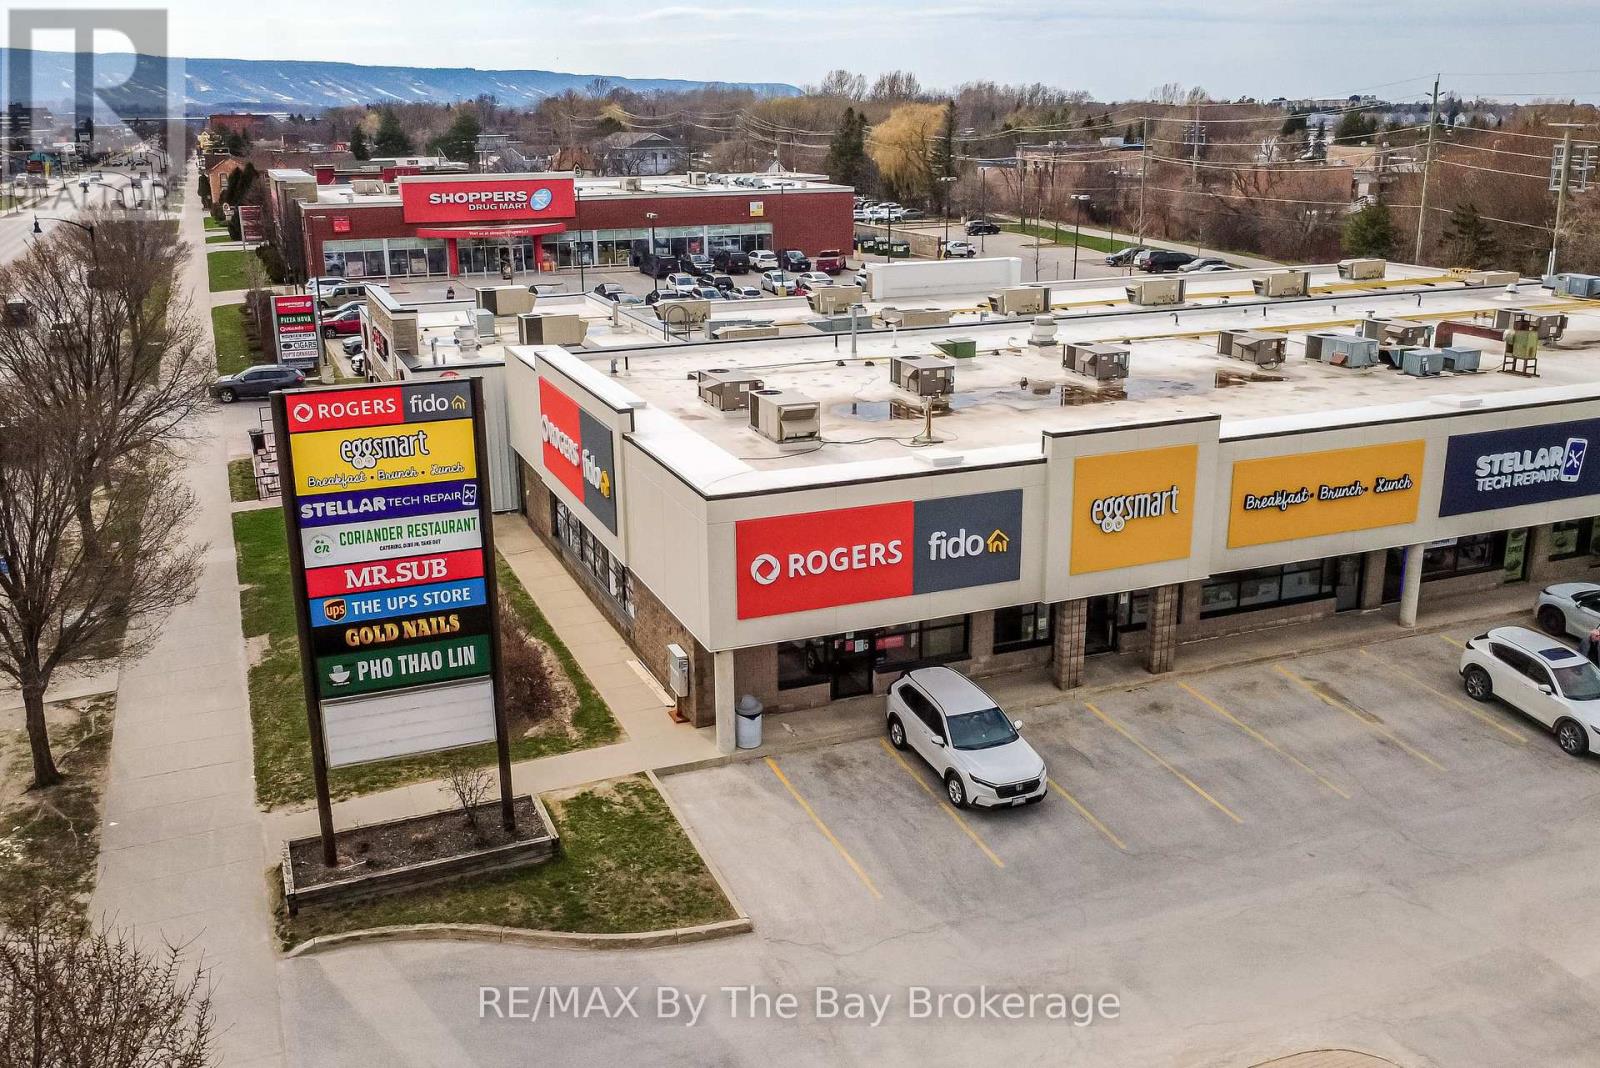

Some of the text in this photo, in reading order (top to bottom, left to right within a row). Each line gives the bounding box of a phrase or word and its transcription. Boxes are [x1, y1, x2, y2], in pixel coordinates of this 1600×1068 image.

[429, 191, 528, 204] SHOPPERS
[500, 202, 528, 210] MART
[318, 398, 396, 420] ROGERS
[410, 394, 448, 414] fido
[340, 430, 430, 470] eggsmart
[1475, 446, 1564, 477] STELLAR
[307, 462, 465, 489] Breakfast Brunch Lunch
[1476, 468, 1560, 492] TECH REPAIR
[301, 491, 462, 519] STELLAR TECH REPAIR
[1244, 474, 1412, 512] Breakfast Brunch Lunch
[1091, 485, 1180, 533] eggsmart
[339, 517, 477, 546] CORIANDER RESTAURANT
[928, 528, 985, 561] fido
[788, 539, 903, 578] ROGERS
[344, 558, 447, 589] MR.SUB
[326, 604, 345, 619] ups
[352, 588, 471, 615] THE UPS STORE
[345, 613, 461, 646] GOLD NAILS
[358, 645, 476, 681] PHO THAO LIN
